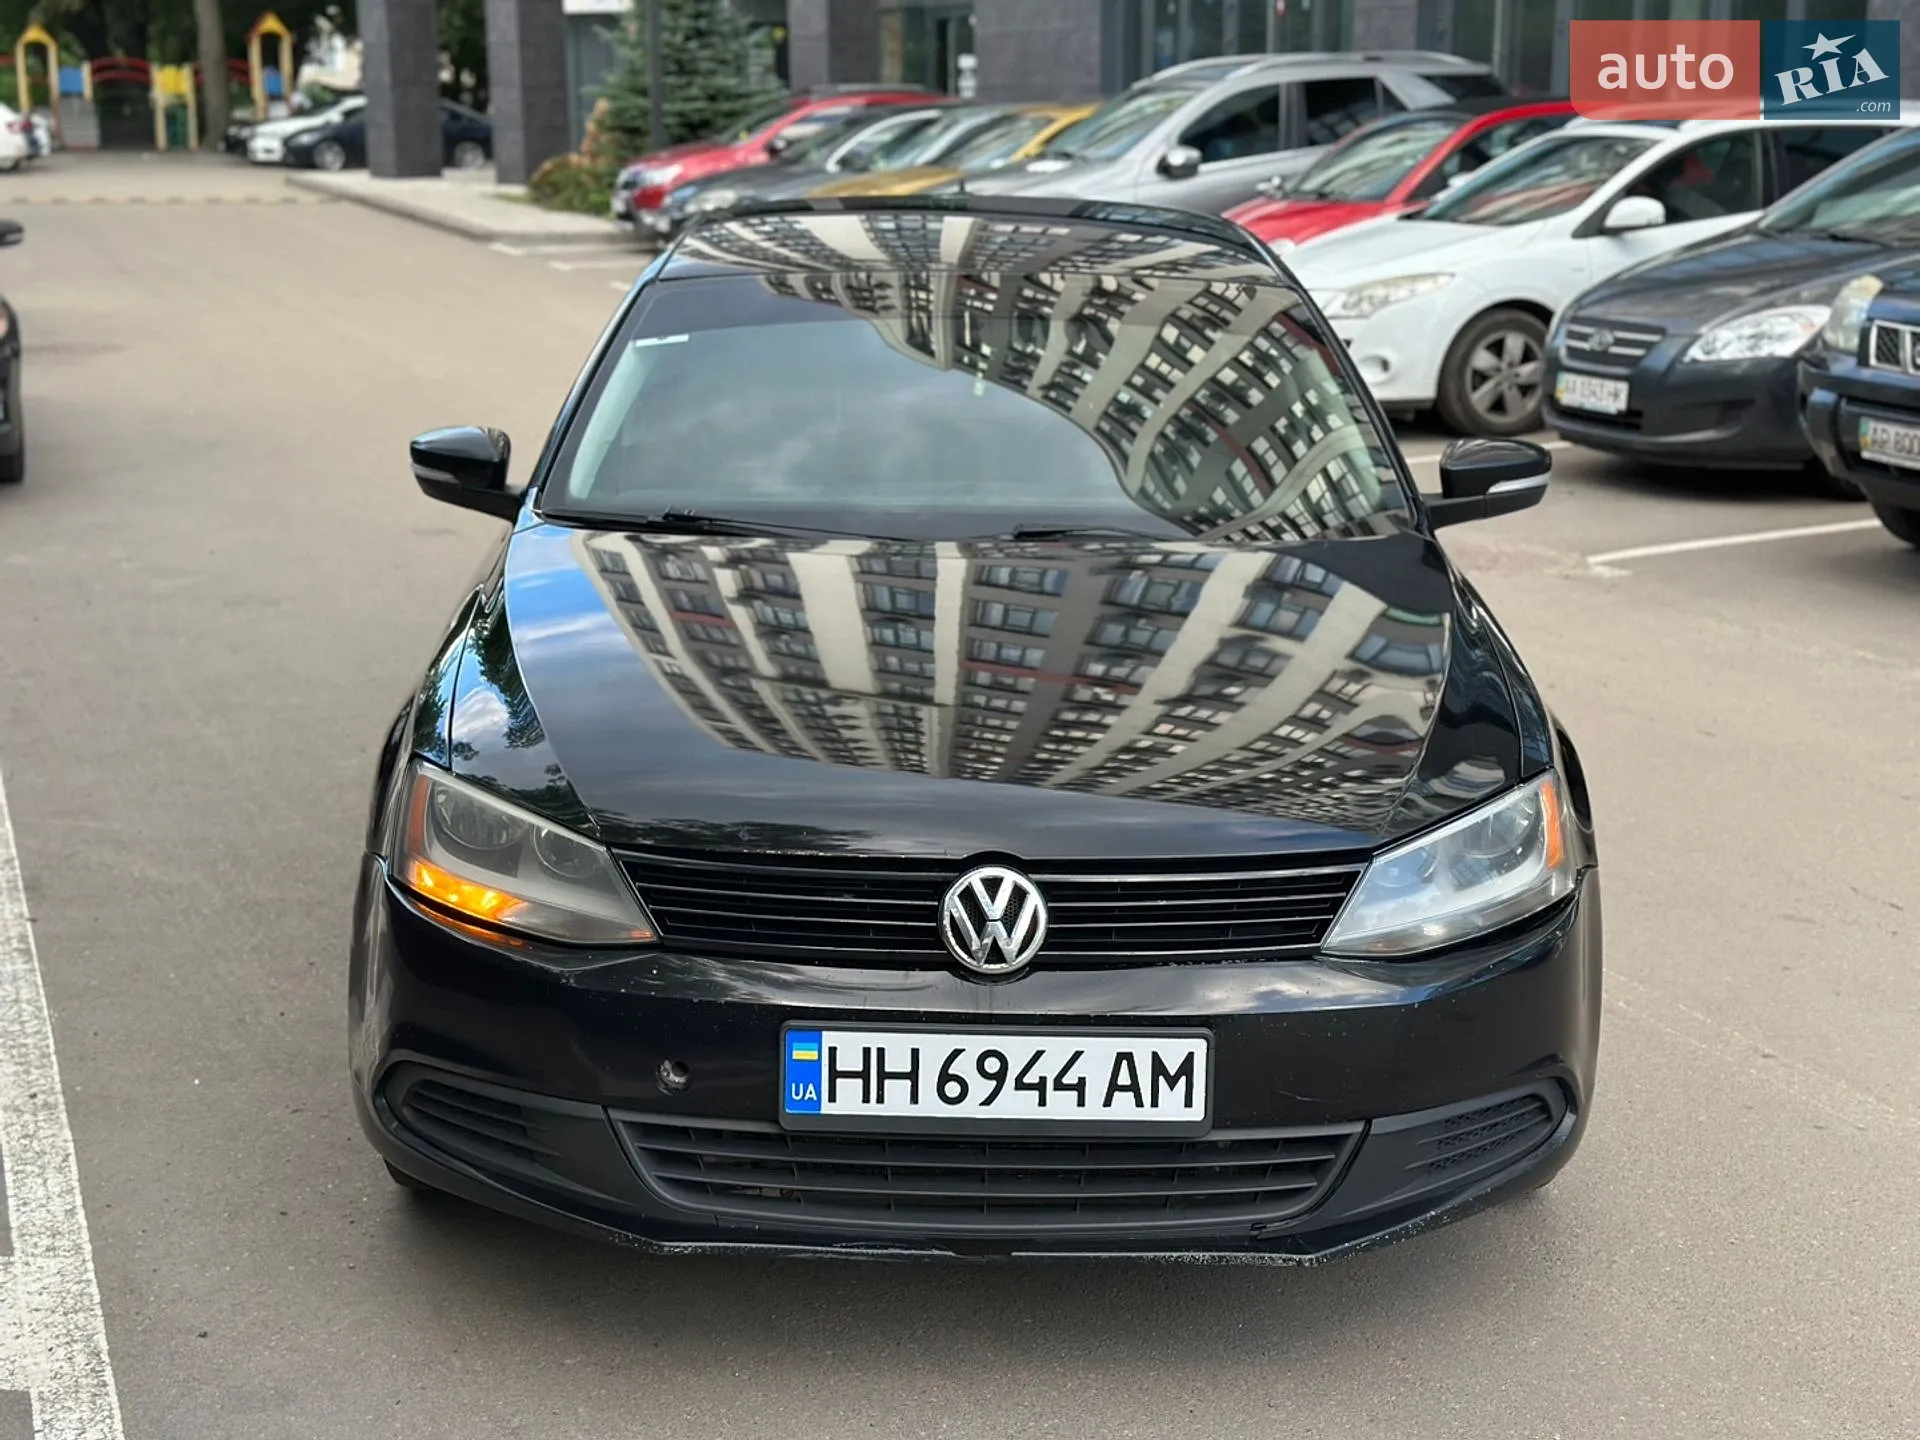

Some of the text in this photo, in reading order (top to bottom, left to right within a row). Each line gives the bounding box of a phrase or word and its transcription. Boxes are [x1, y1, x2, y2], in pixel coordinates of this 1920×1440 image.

[791, 1083, 818, 1101] UA
[827, 1046, 1195, 1109] HH 6944 AM
